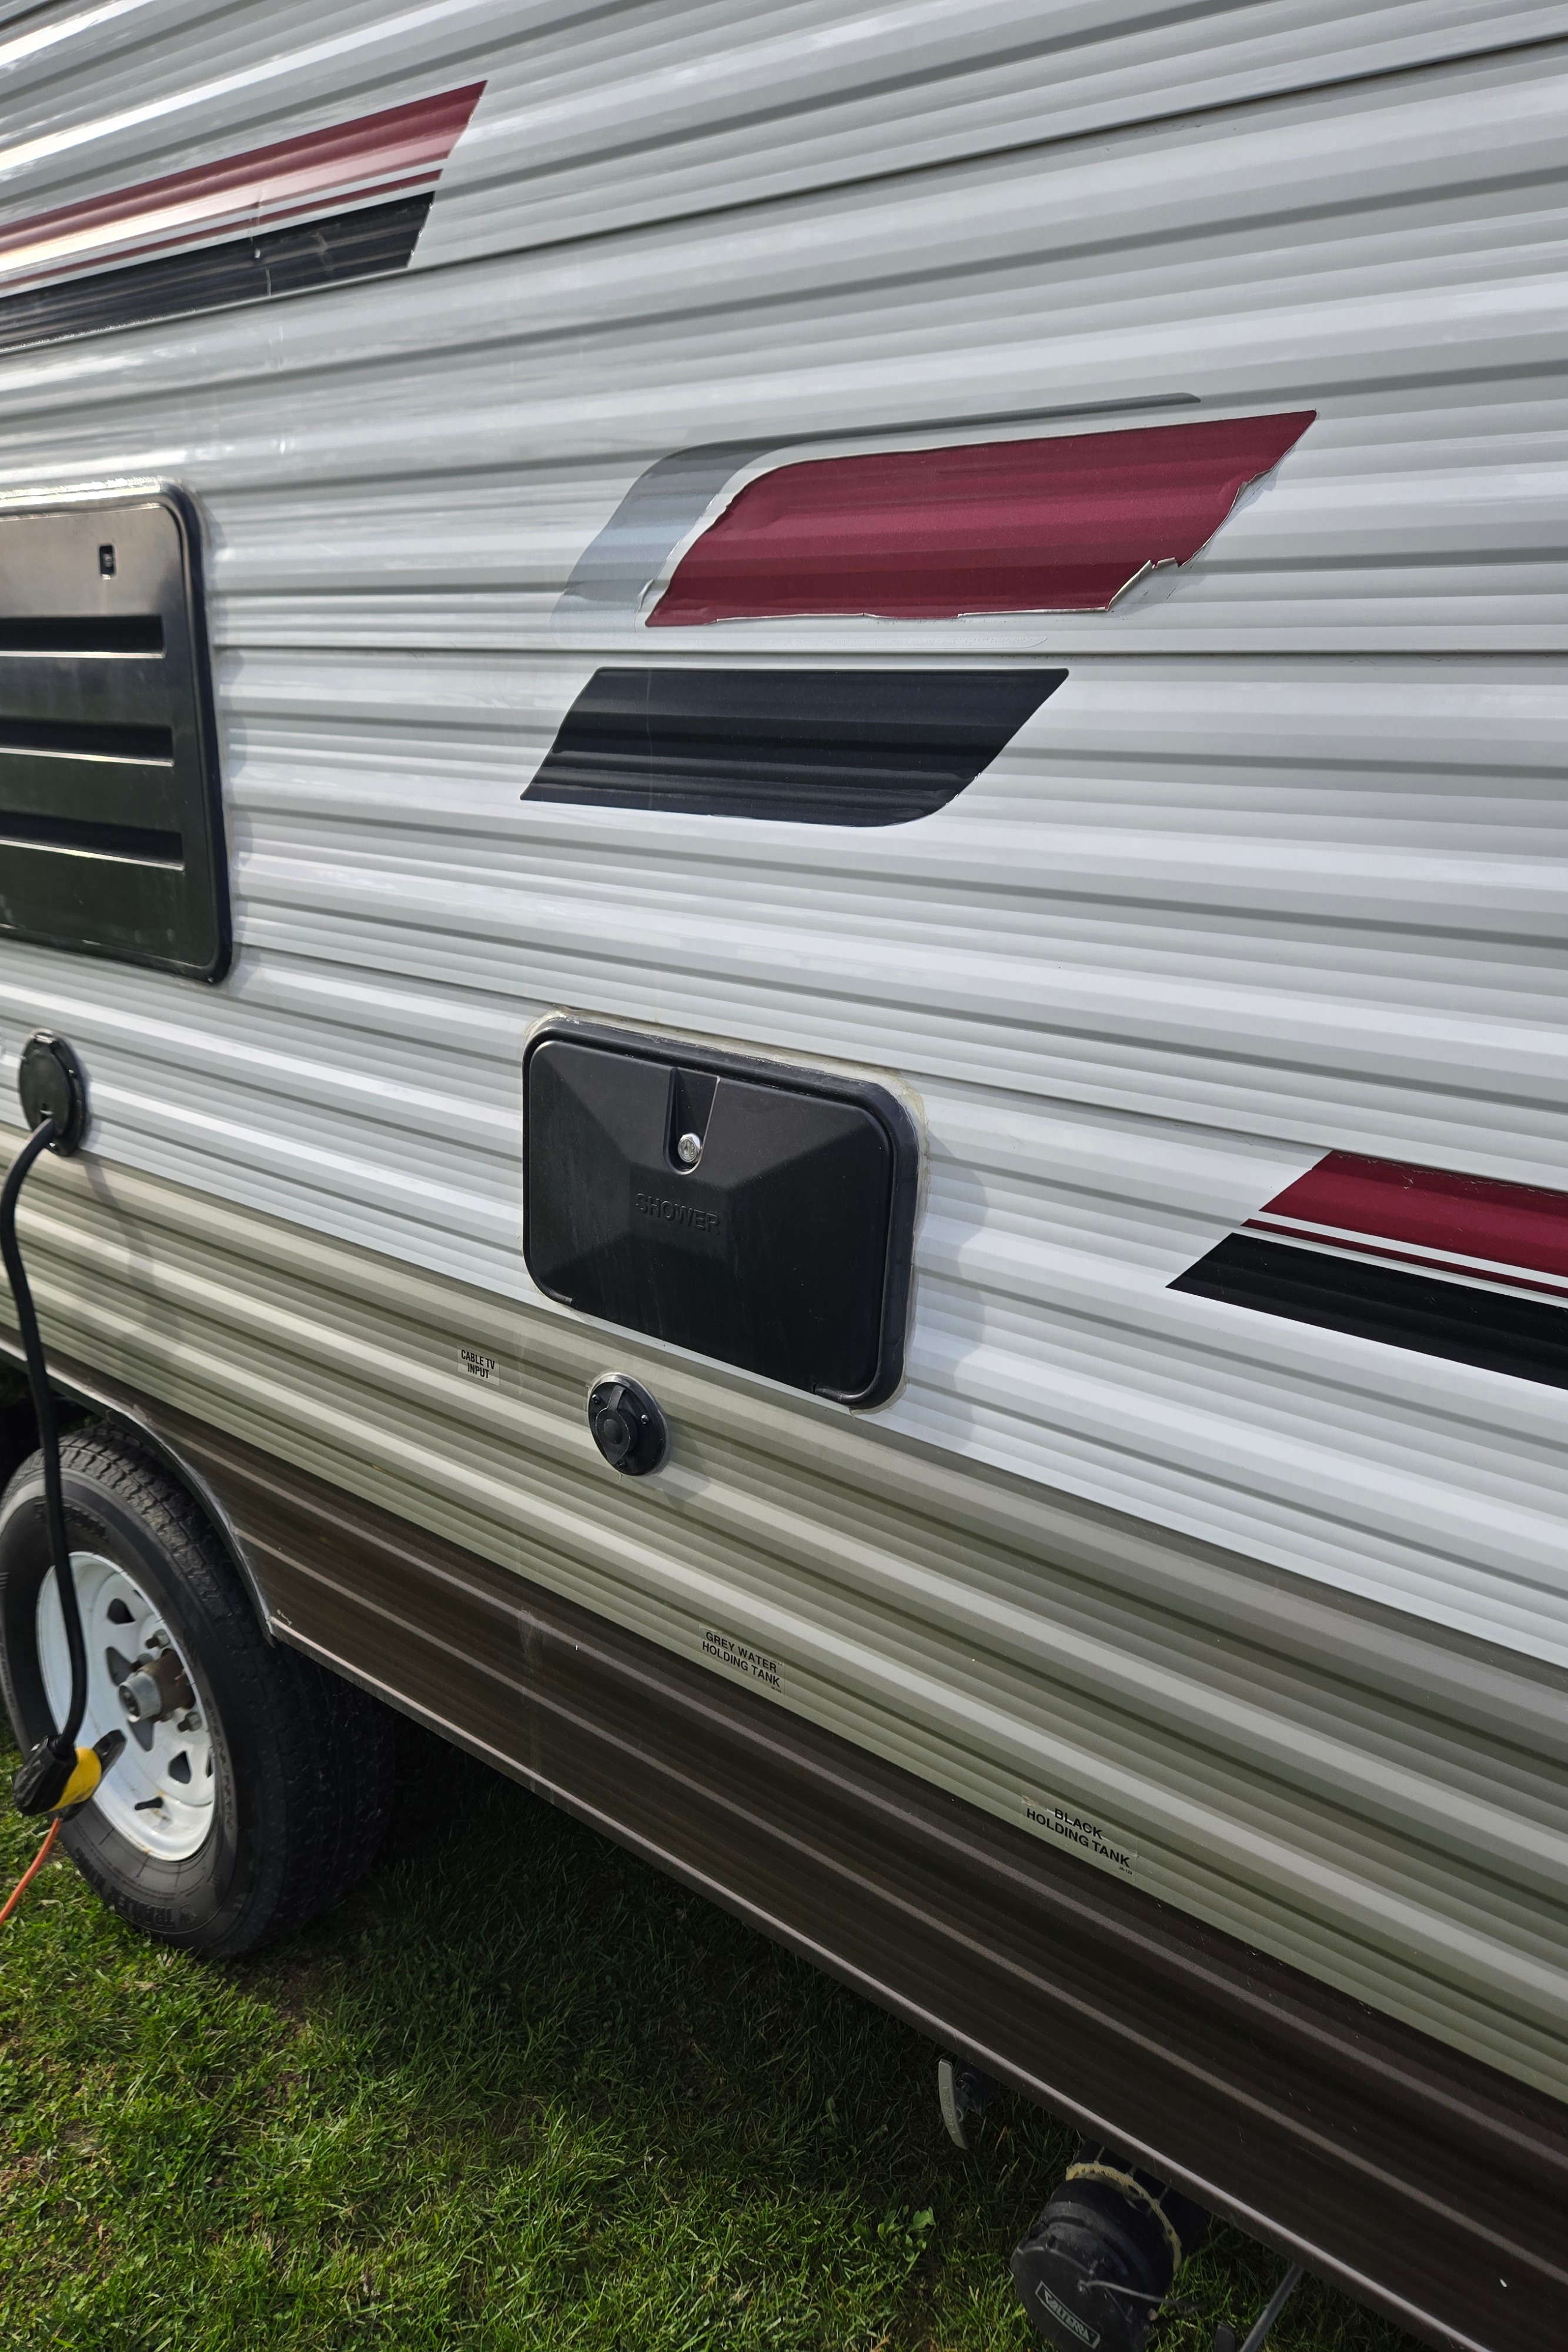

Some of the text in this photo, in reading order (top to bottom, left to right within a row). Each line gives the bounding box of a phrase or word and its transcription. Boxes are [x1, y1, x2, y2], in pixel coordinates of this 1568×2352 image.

[636, 1192, 720, 1235] SHOWER
[461, 1349, 495, 1369] CABLE TV
[467, 1362, 490, 1379] INPUT
[702, 1641, 780, 1688] HOLDING TANK
[706, 1632, 777, 1673] GREY WATER
[1027, 1808, 1131, 1867] HOLDING TANK
[1055, 1808, 1103, 1840] BLACK
